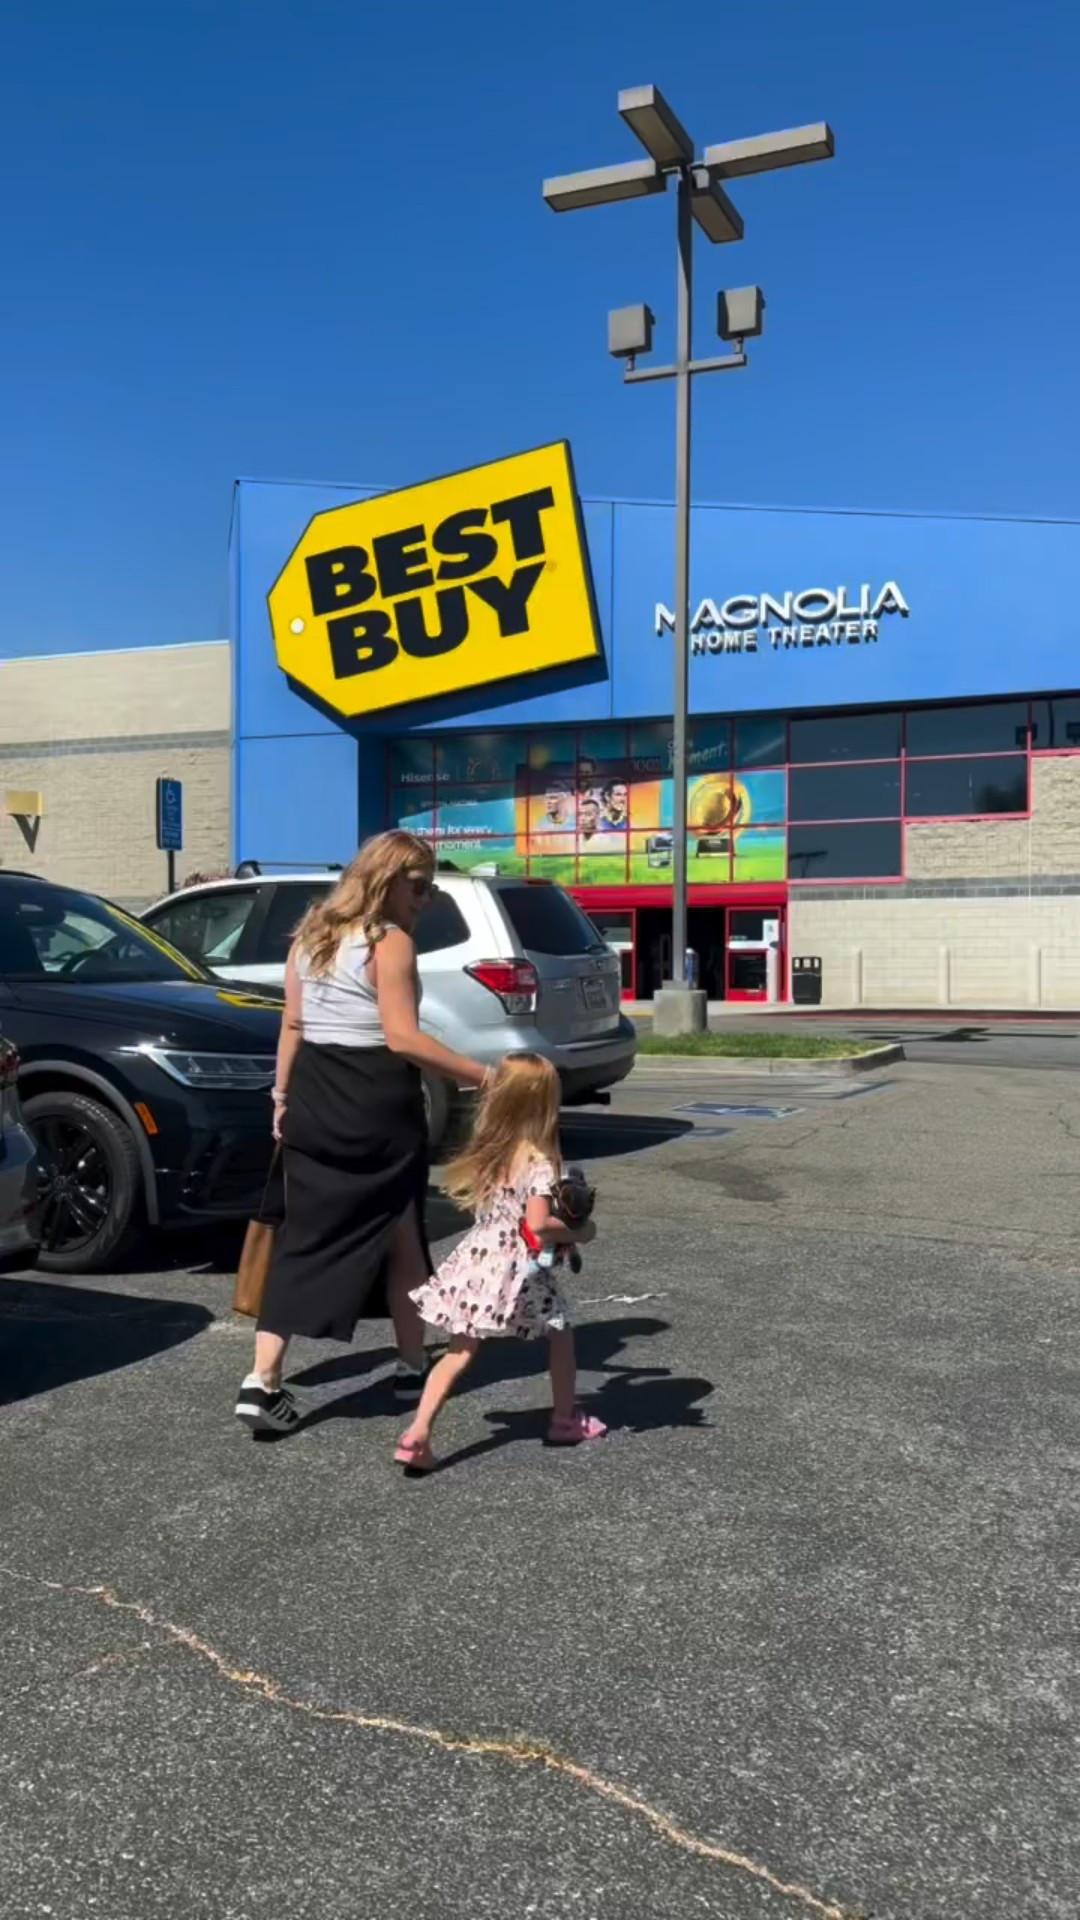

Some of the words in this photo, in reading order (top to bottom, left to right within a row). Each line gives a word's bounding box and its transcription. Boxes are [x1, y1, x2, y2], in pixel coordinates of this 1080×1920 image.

[305, 486, 555, 617] BEST
[326, 561, 546, 680] BUY
[690, 630, 758, 656] HOME
[768, 619, 878, 650] THEATER
[401, 772, 450, 783] Hisense
